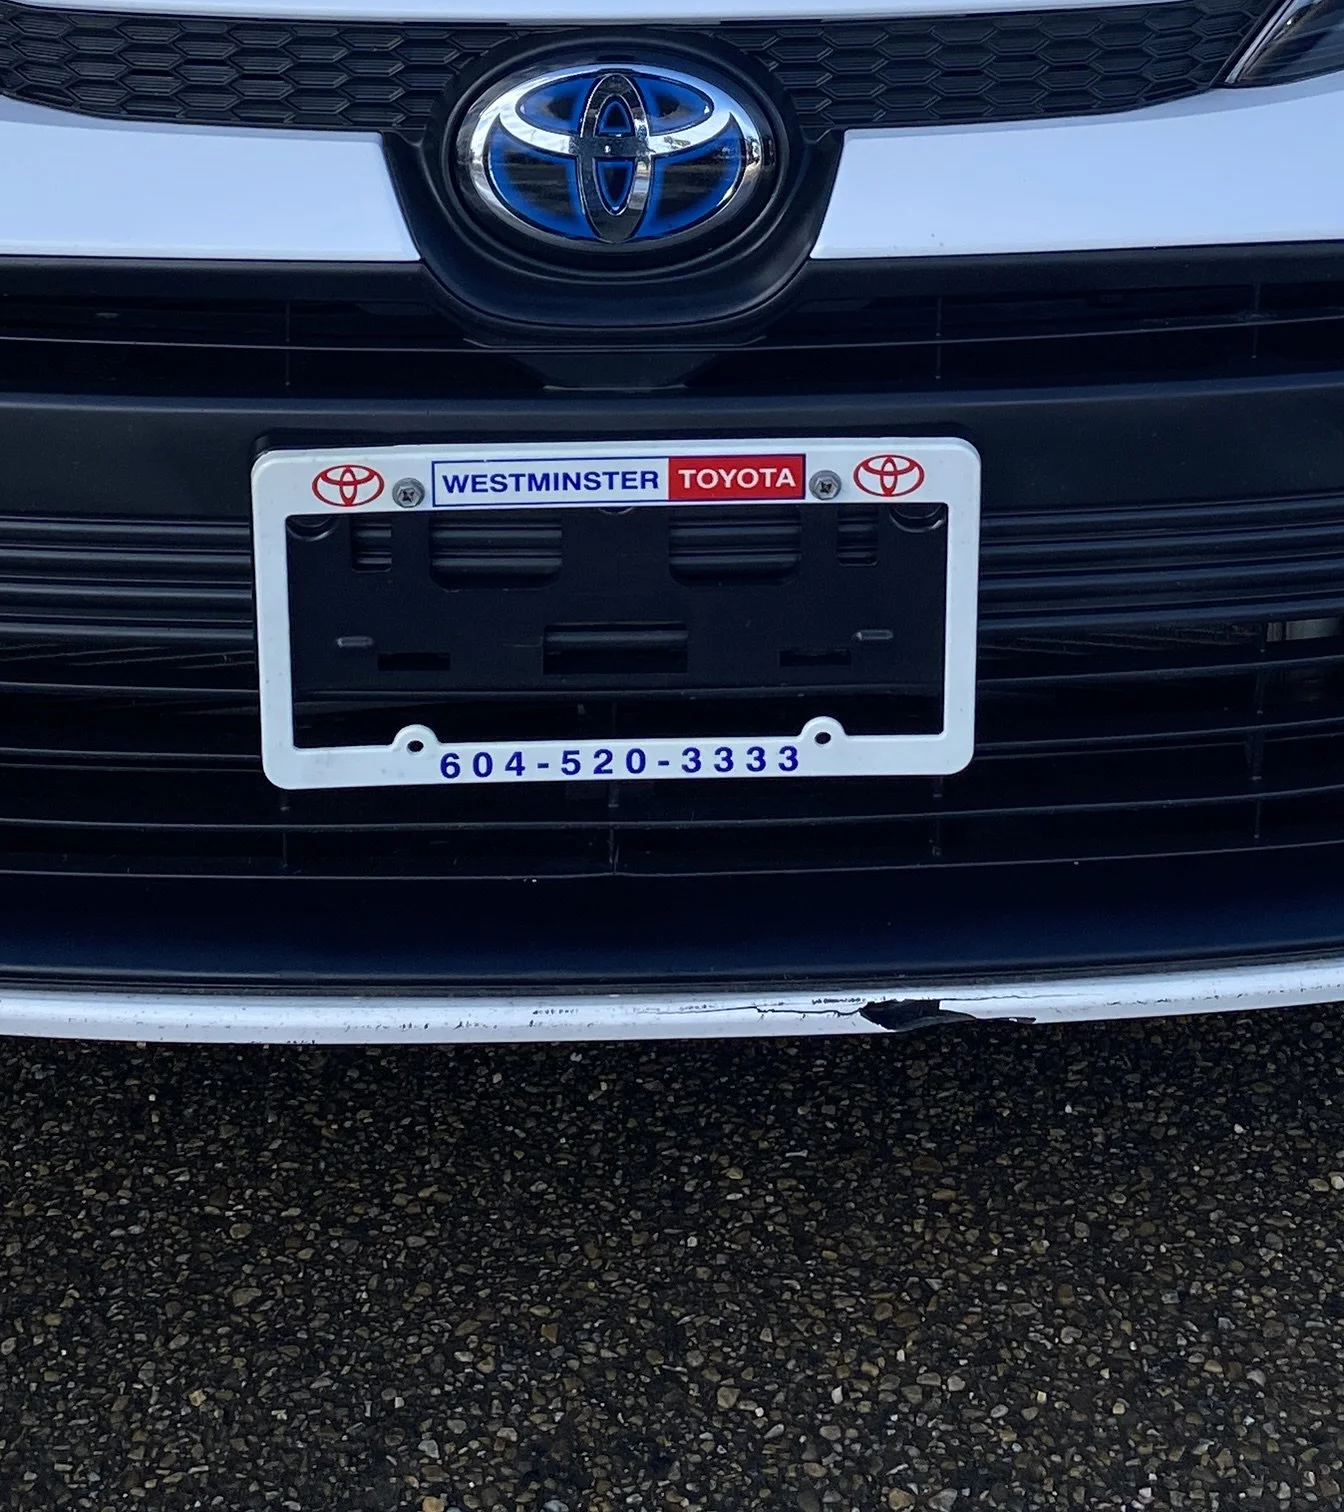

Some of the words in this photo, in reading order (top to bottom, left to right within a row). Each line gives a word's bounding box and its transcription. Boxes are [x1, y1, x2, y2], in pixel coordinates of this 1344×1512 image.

[441, 469, 660, 494] WESTMINSTER
[677, 467, 797, 490] TOYOTA
[439, 745, 800, 779] 604-520-3333
